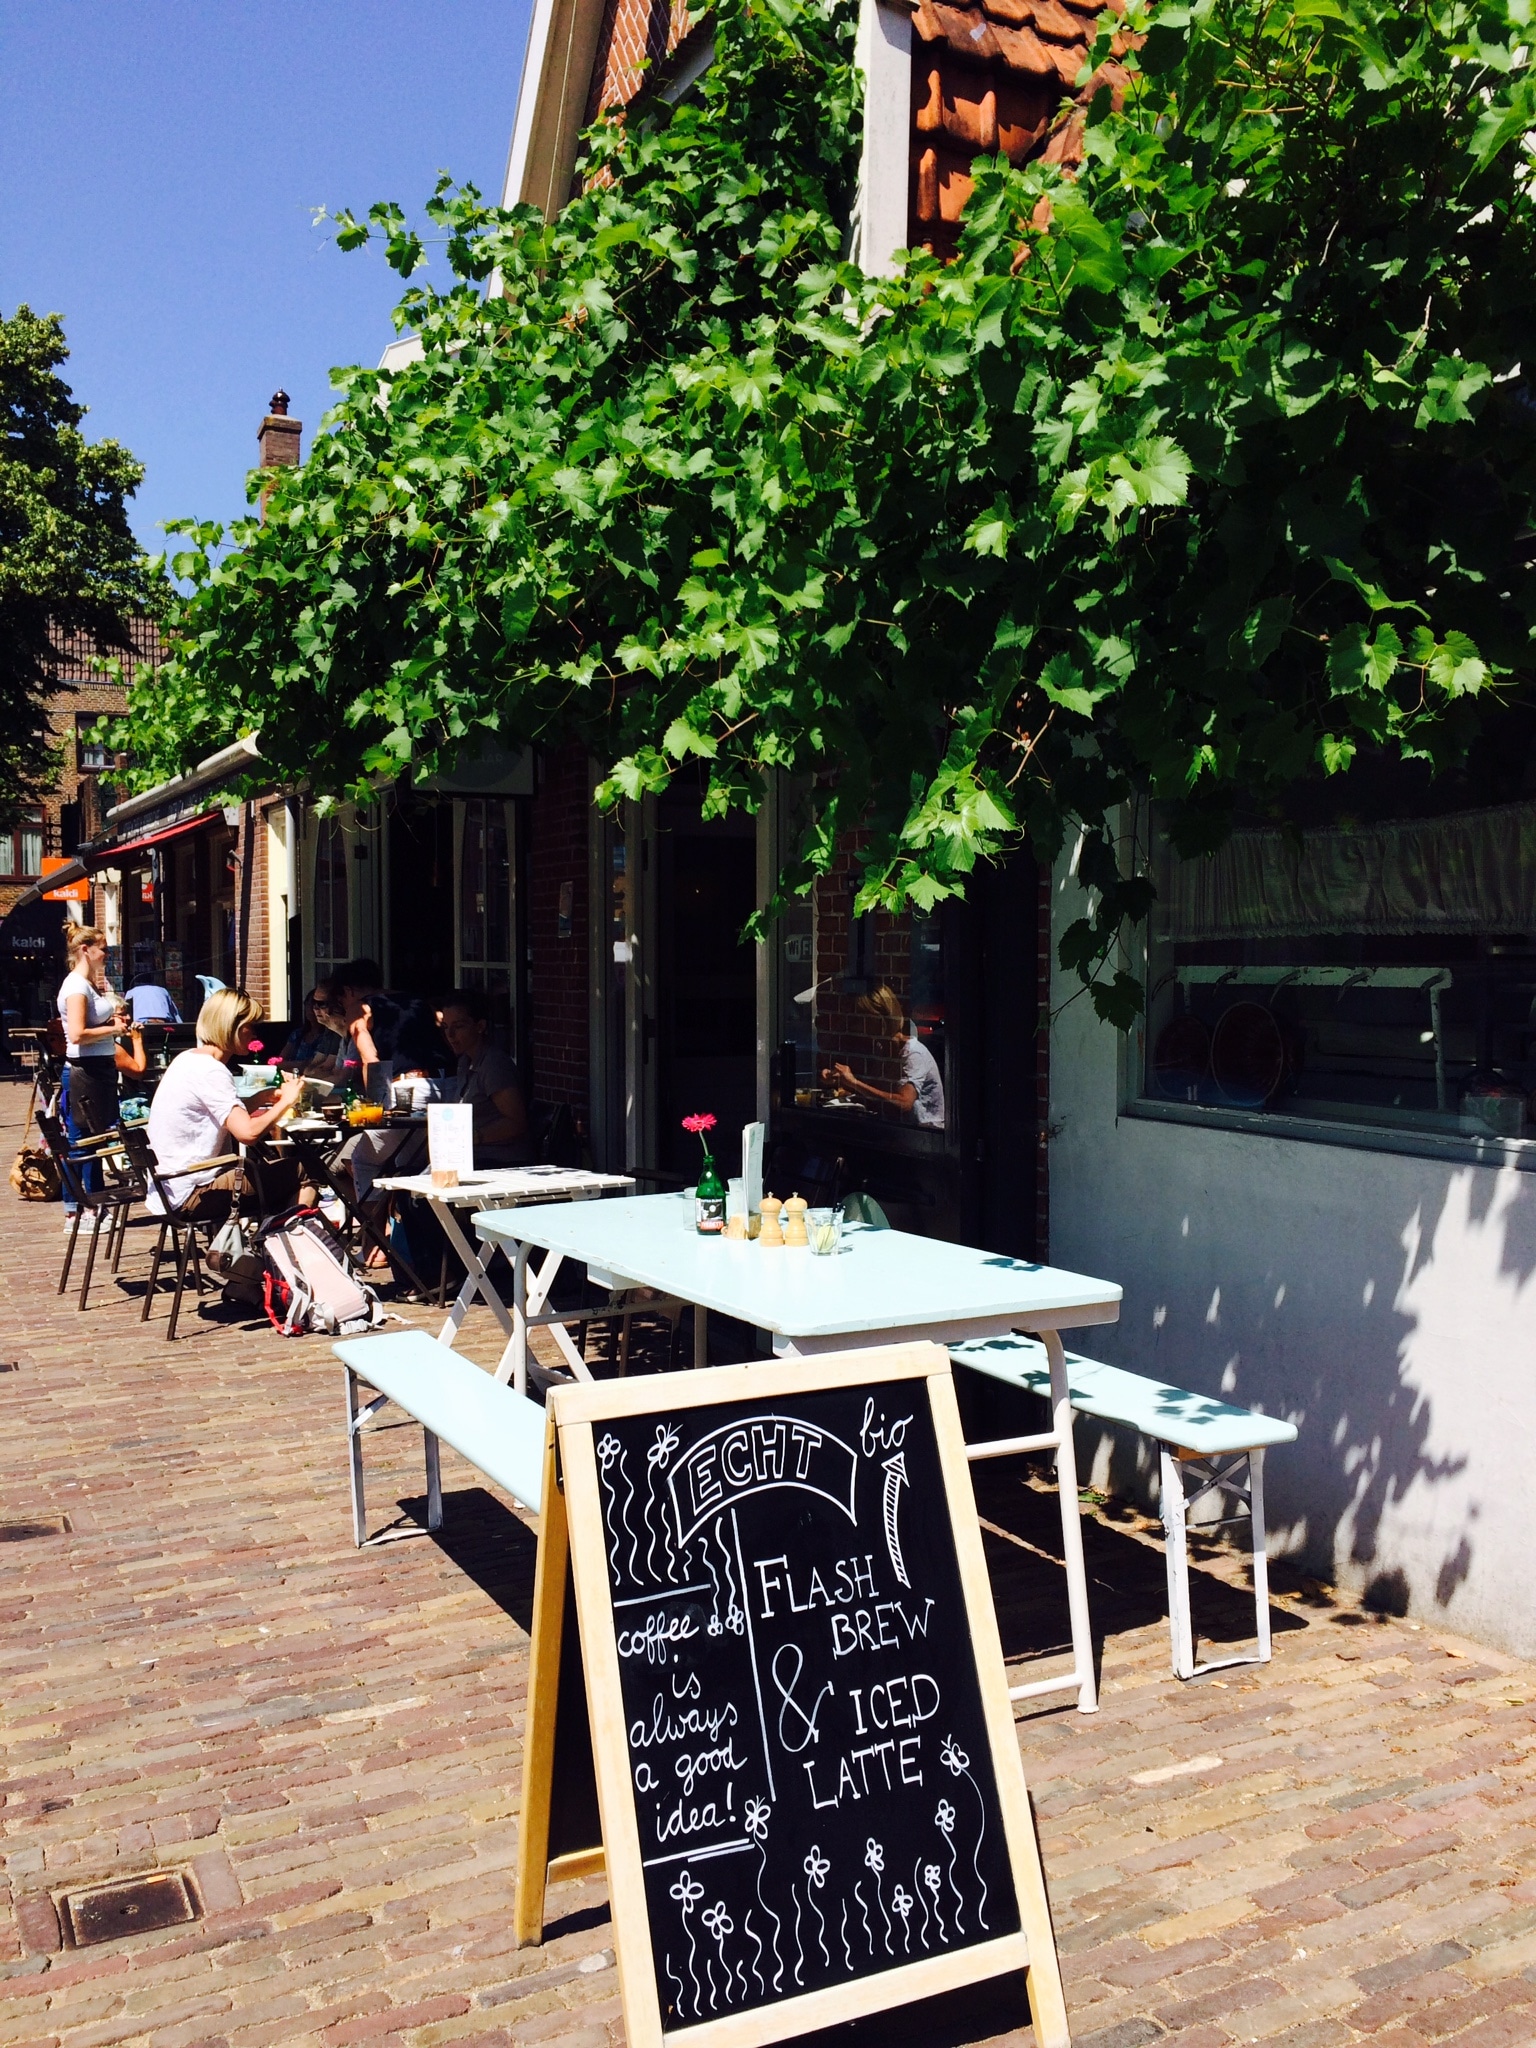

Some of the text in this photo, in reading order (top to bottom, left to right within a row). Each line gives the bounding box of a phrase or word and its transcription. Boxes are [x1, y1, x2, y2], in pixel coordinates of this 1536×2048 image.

[53, 889, 79, 898] kaldi
[12, 936, 46, 948] kaldi
[860, 1396, 914, 1458] bio
[687, 1423, 822, 1516] ECHT
[753, 1554, 880, 1619] FLASH
[617, 1610, 700, 1665] coffee
[831, 1597, 935, 1660] BREW
[671, 1654, 701, 1699] is
[771, 1643, 940, 1753] & ICED
[629, 1692, 738, 1748] always
[635, 1737, 748, 1797] a good
[802, 1735, 923, 1809] LATTE
[656, 1782, 737, 1843] idea!
